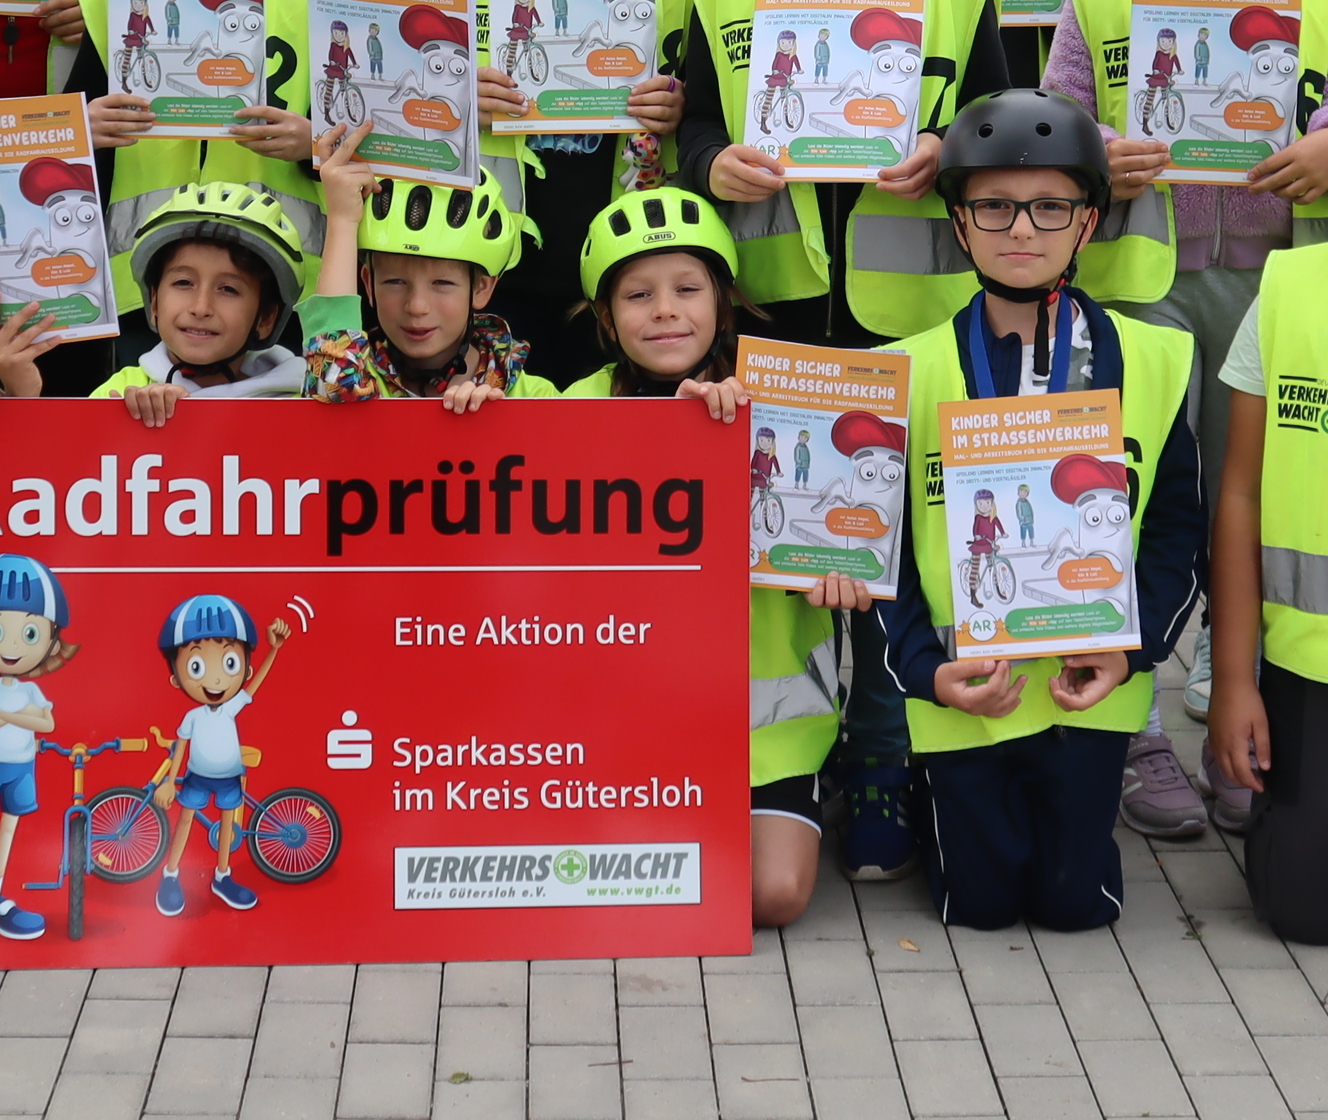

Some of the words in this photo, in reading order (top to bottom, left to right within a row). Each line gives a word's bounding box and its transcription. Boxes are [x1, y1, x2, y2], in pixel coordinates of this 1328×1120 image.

[921, 56, 956, 128] 7
[648, 233, 672, 241] ABUS
[746, 352, 791, 371] KINDER
[795, 359, 841, 377] SICHER
[745, 370, 760, 385] IM
[763, 373, 896, 400] STRASSENVERKEHR
[951, 413, 999, 431] KINDER
[1003, 409, 1051, 427] SICHER
[1277, 402, 1321, 423] WACHT
[952, 434, 968, 449] IM
[972, 423, 1109, 448] STRASSENVERKEHR
[394, 616, 466, 646] Eine
[475, 615, 585, 645] Aktion
[596, 614, 651, 644] der
[972, 620, 991, 632] AR
[392, 735, 585, 774] Sparkassen
[393, 781, 433, 811] im
[446, 780, 529, 810] Kreis
[540, 777, 702, 809] Gütersloh
[406, 854, 552, 884] VERKEHRS
[588, 851, 689, 880] WACHT
[407, 887, 442, 900] Kreis
[449, 886, 515, 899] Gütersloh
[522, 885, 546, 898] e.V.
[586, 883, 681, 898] www.vwgt.de
